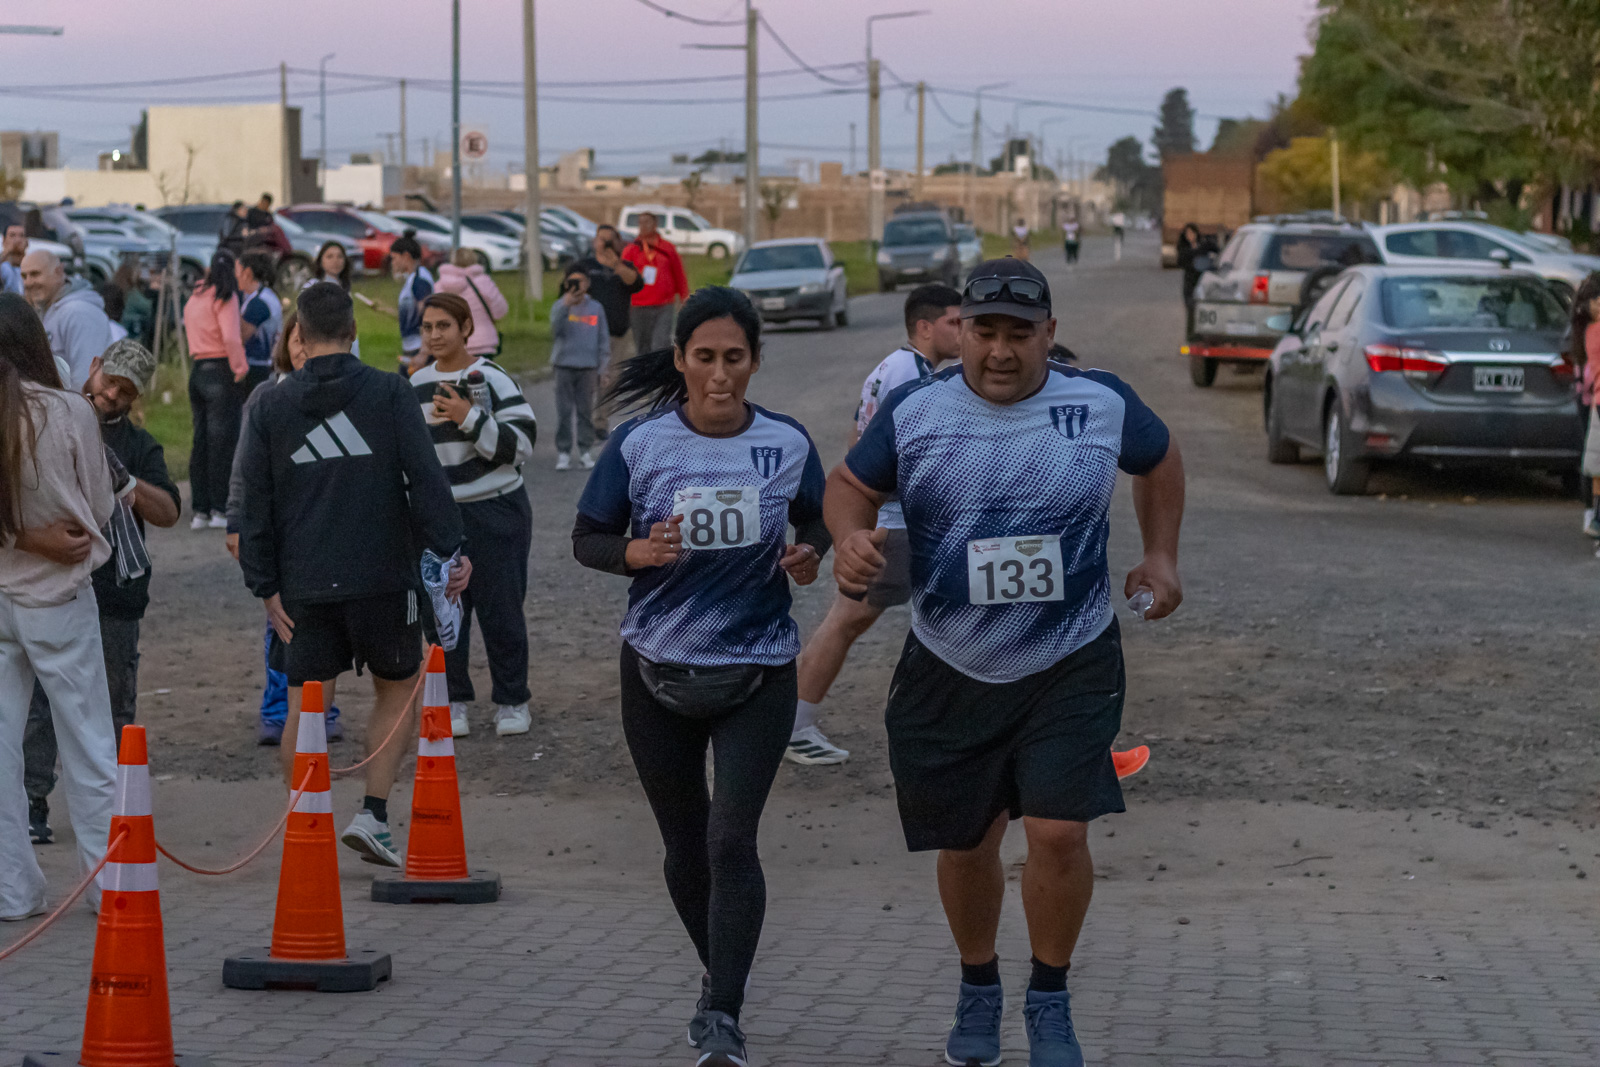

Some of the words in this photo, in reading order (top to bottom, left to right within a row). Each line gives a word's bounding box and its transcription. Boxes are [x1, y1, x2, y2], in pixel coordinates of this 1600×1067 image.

[1056, 407, 1082, 416] SFC
[756, 448, 777, 457] SFC
[690, 508, 744, 546] 80
[977, 558, 1054, 600] 133
